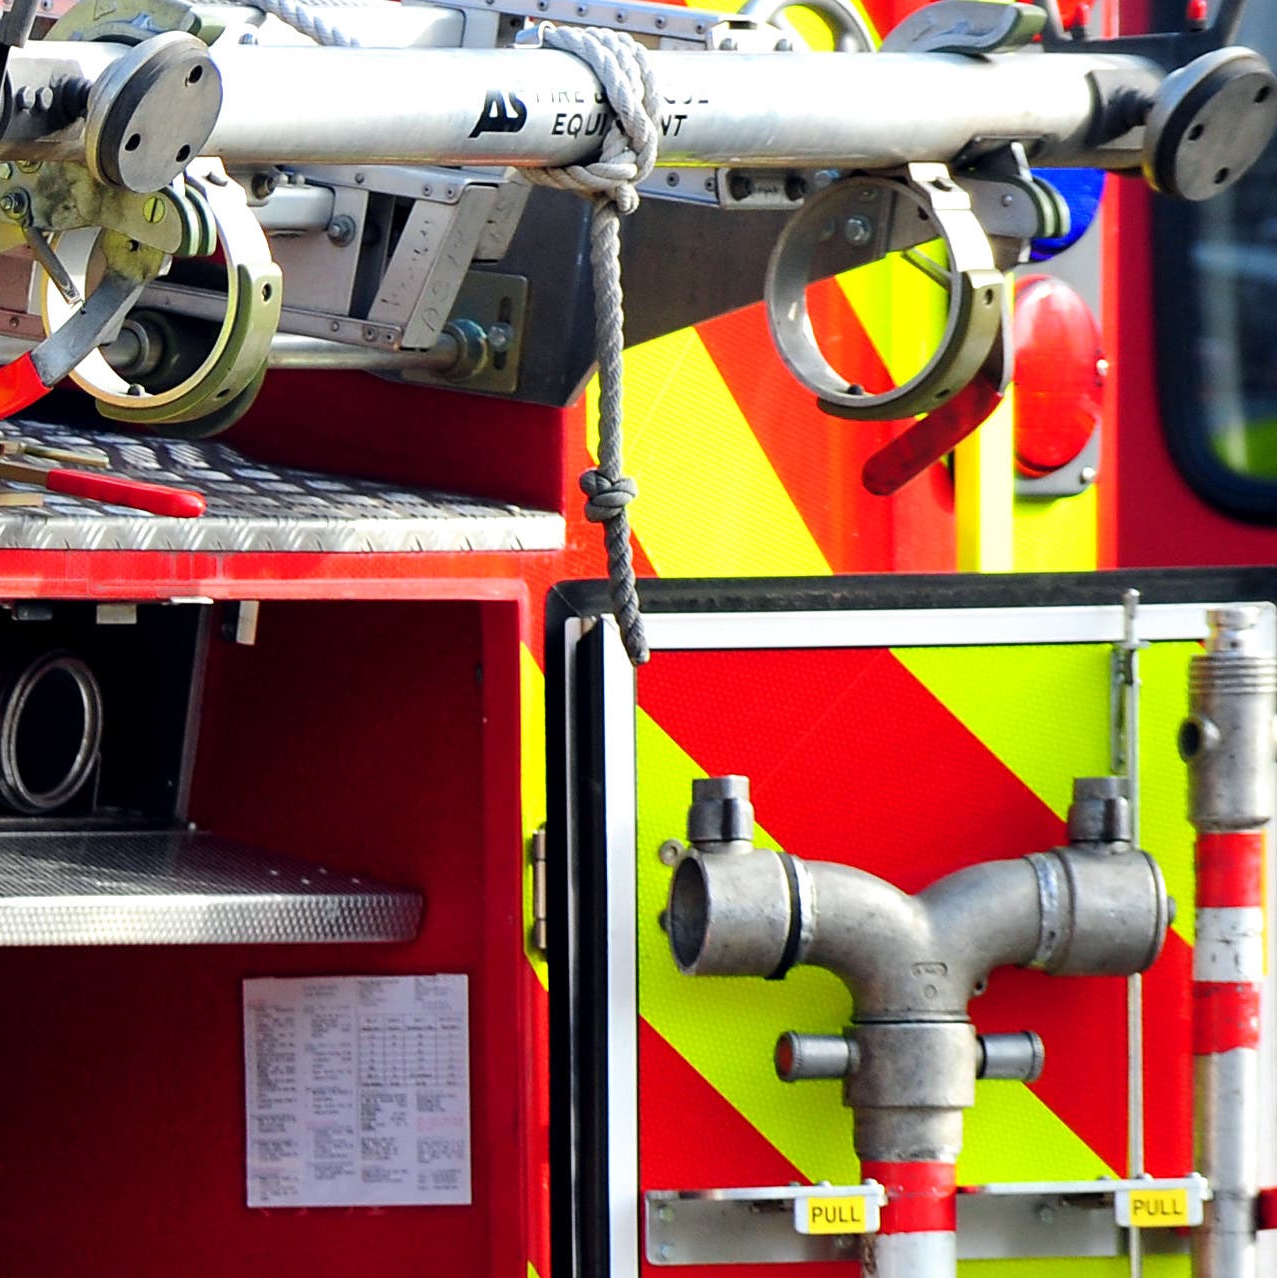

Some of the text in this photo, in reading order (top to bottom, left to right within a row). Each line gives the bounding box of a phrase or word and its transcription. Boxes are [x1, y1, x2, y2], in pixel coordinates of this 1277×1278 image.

[551, 113, 688, 138] EQUINT
[811, 1205, 861, 1223] PULL
[1133, 1198, 1183, 1216] PULL
